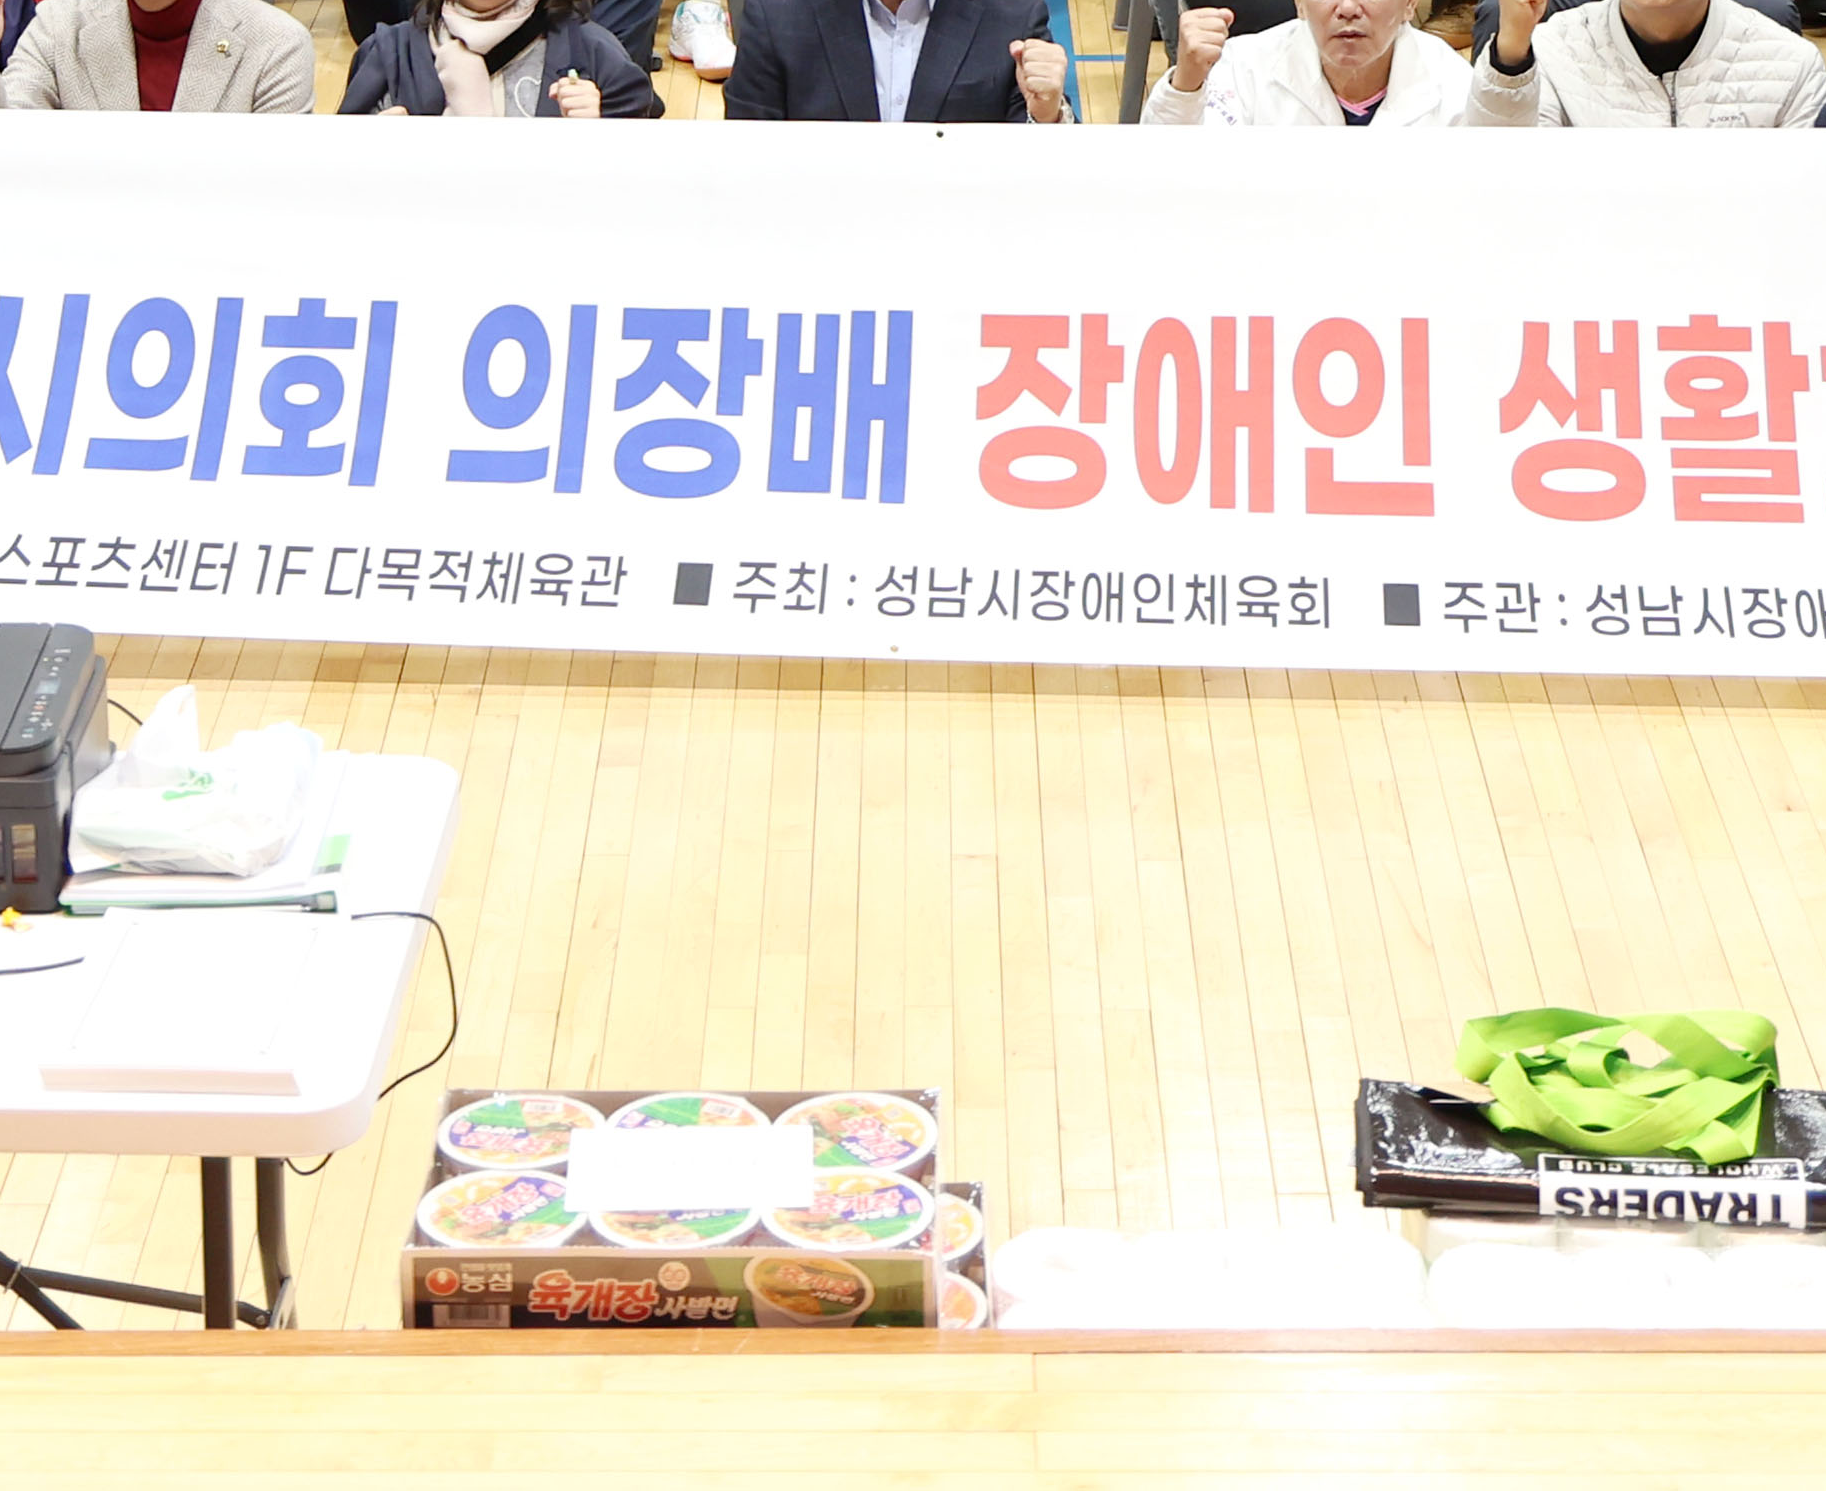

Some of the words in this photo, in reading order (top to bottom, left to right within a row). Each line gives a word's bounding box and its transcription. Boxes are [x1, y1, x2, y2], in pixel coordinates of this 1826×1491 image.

[445, 304, 914, 504] 의장배
[975, 313, 1435, 517] 장애인
[256, 545, 314, 595] 1F
[324, 548, 627, 606] 다목적체육관
[874, 567, 1331, 628] 성남시장애인체육회
[1554, 1186, 1790, 1225] TRADERS
[460, 1272, 513, 1293] 농심
[528, 1269, 659, 1321] 육개장
[655, 1296, 739, 1321] 사발면
